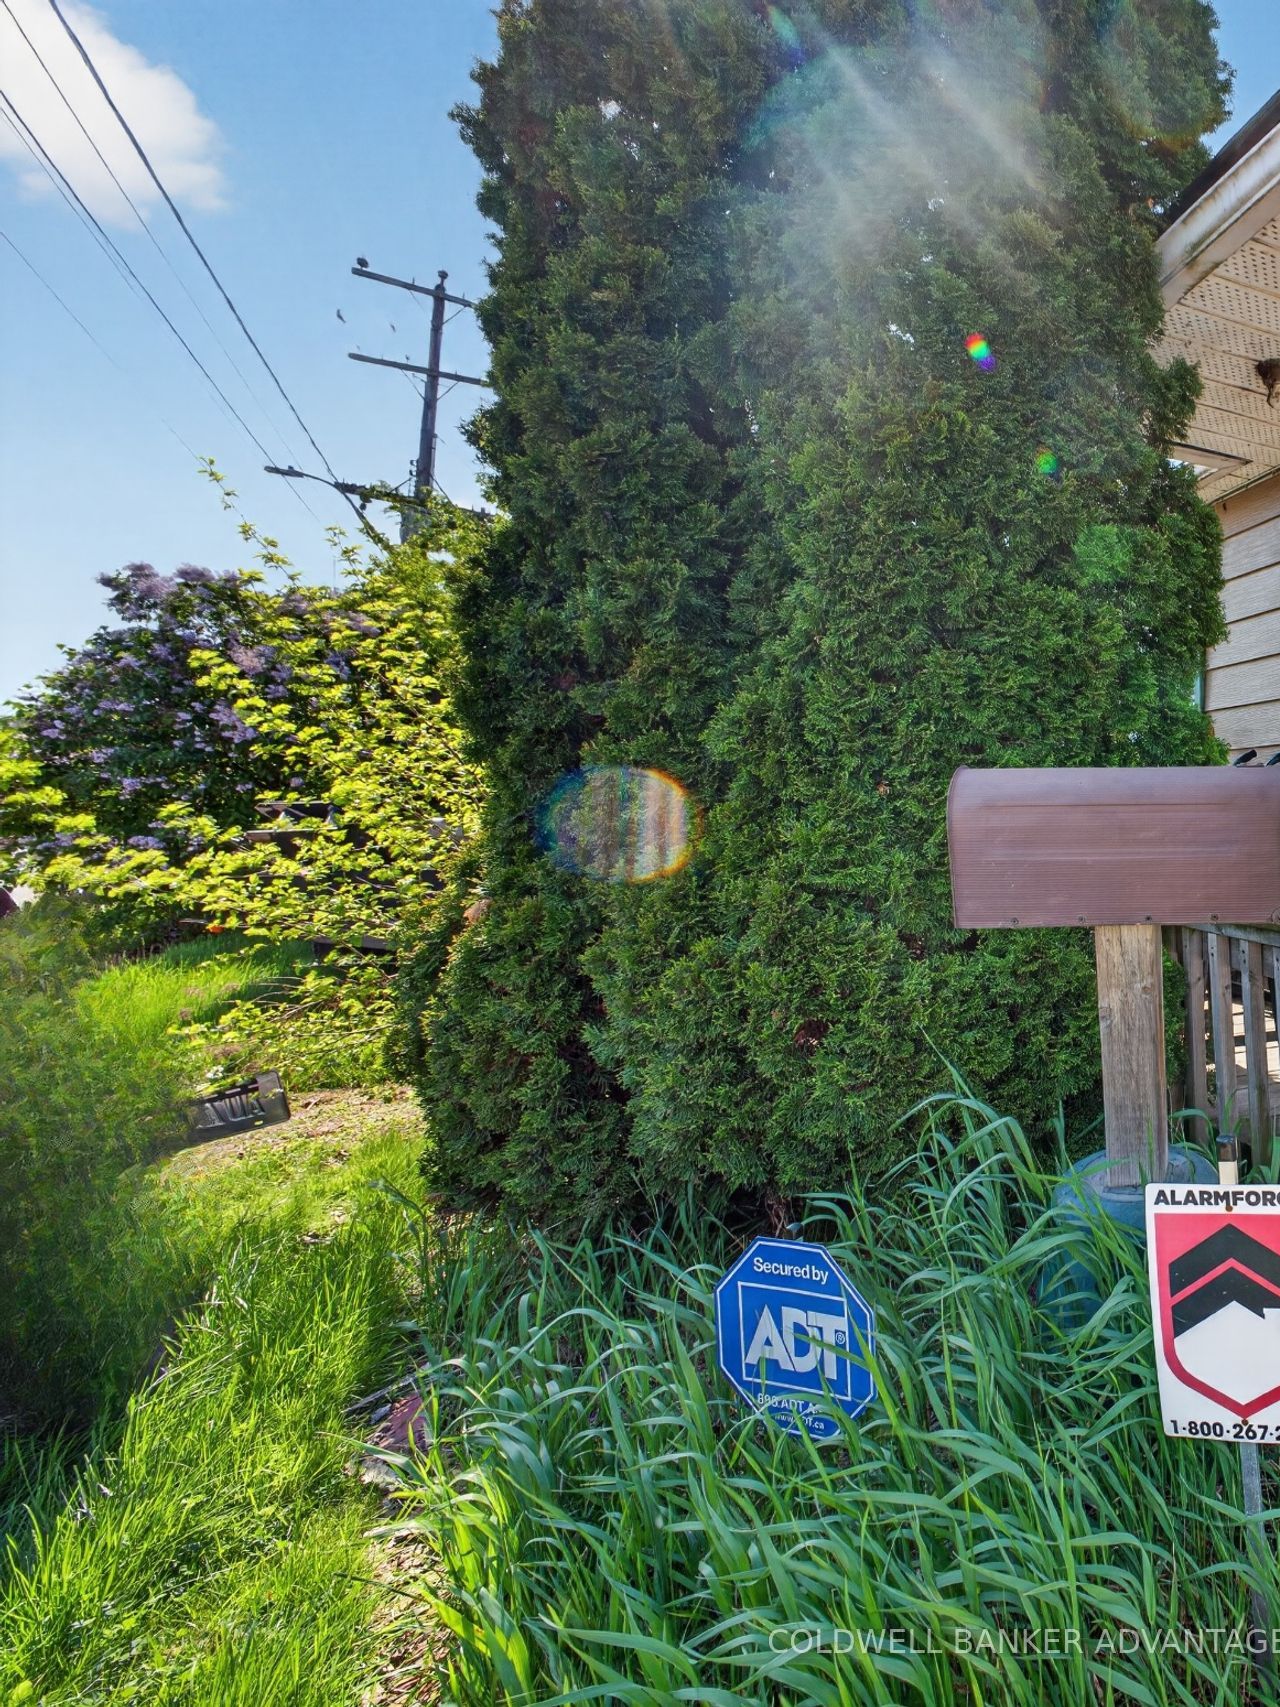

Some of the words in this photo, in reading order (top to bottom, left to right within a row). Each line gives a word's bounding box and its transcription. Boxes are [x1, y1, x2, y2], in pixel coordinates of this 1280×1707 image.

[753, 1257, 810, 1279] Secured
[812, 1265, 829, 1284] by
[745, 1303, 847, 1380] ADT
